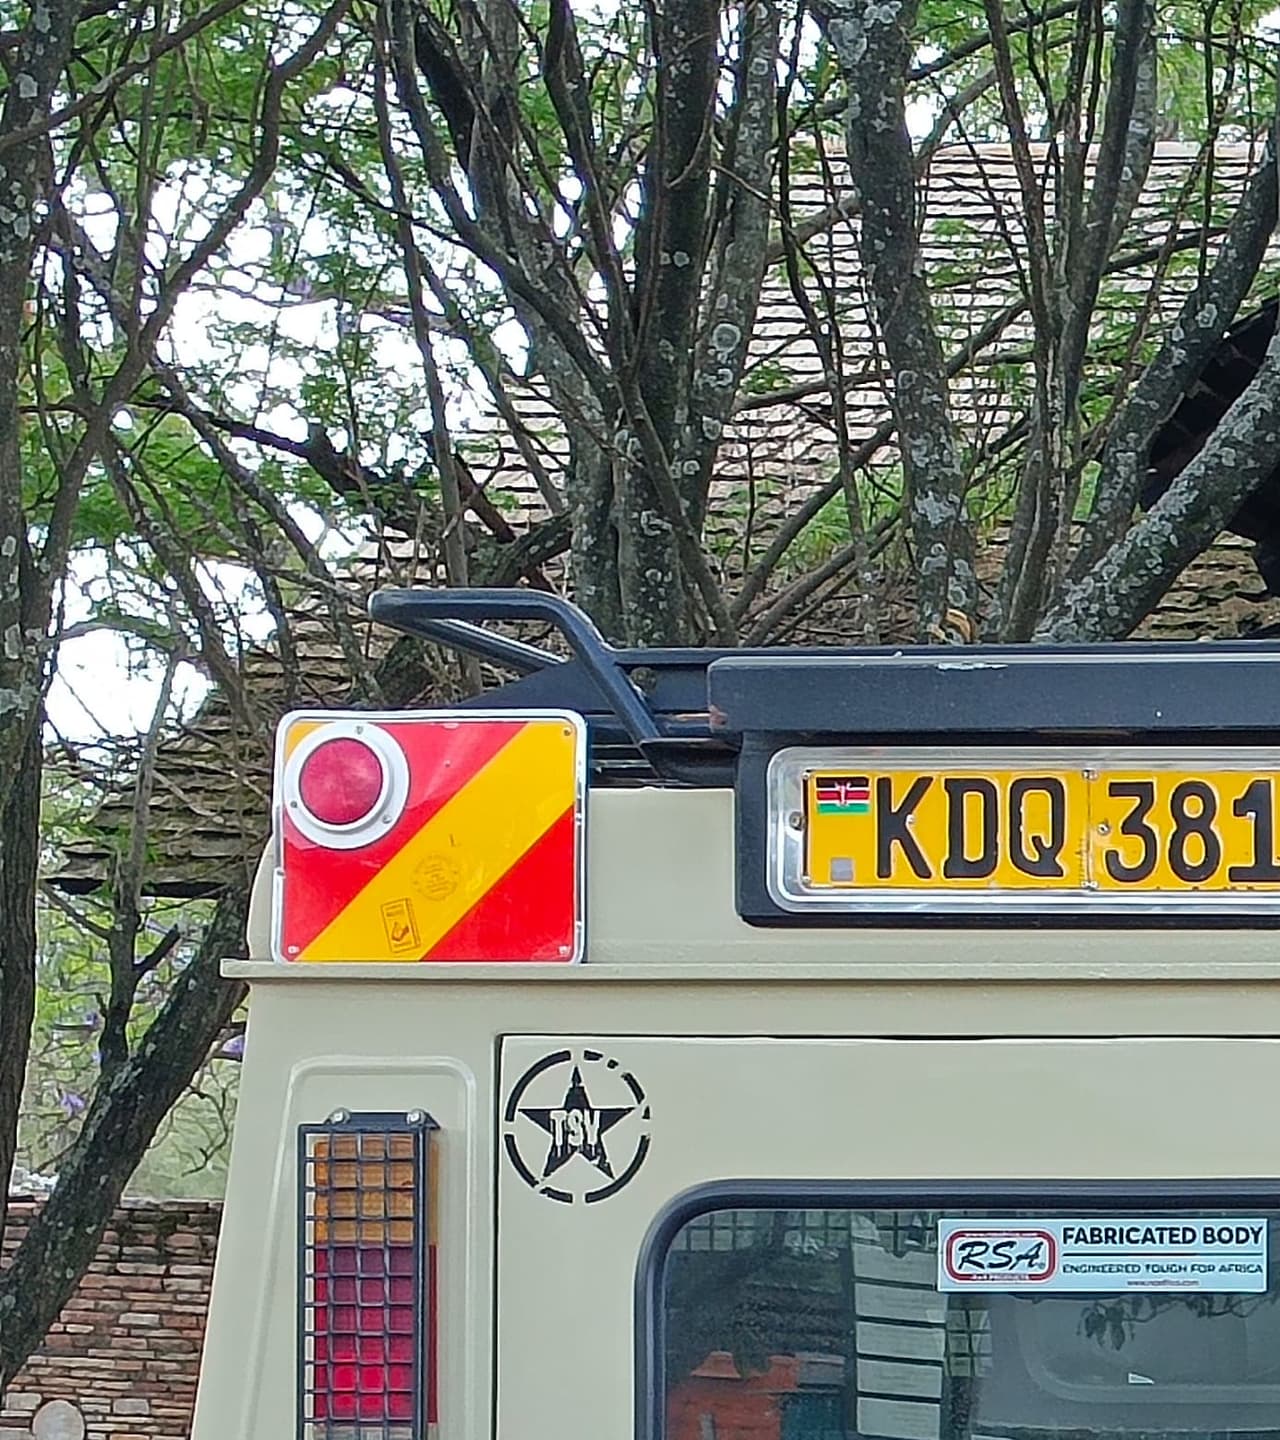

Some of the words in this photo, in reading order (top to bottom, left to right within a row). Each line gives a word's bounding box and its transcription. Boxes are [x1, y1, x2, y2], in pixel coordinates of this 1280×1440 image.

[876, 776, 1066, 880] KDQ
[1062, 1227, 1197, 1245] FABRICATED
[1203, 1227, 1263, 1245] BODY
[957, 1240, 1044, 1271] RSA
[1062, 1263, 1141, 1274] ENGINEERED
[1145, 1263, 1188, 1274] TOUGH
[1190, 1264, 1216, 1274] FOR
[1218, 1264, 1263, 1274] AFRICA
